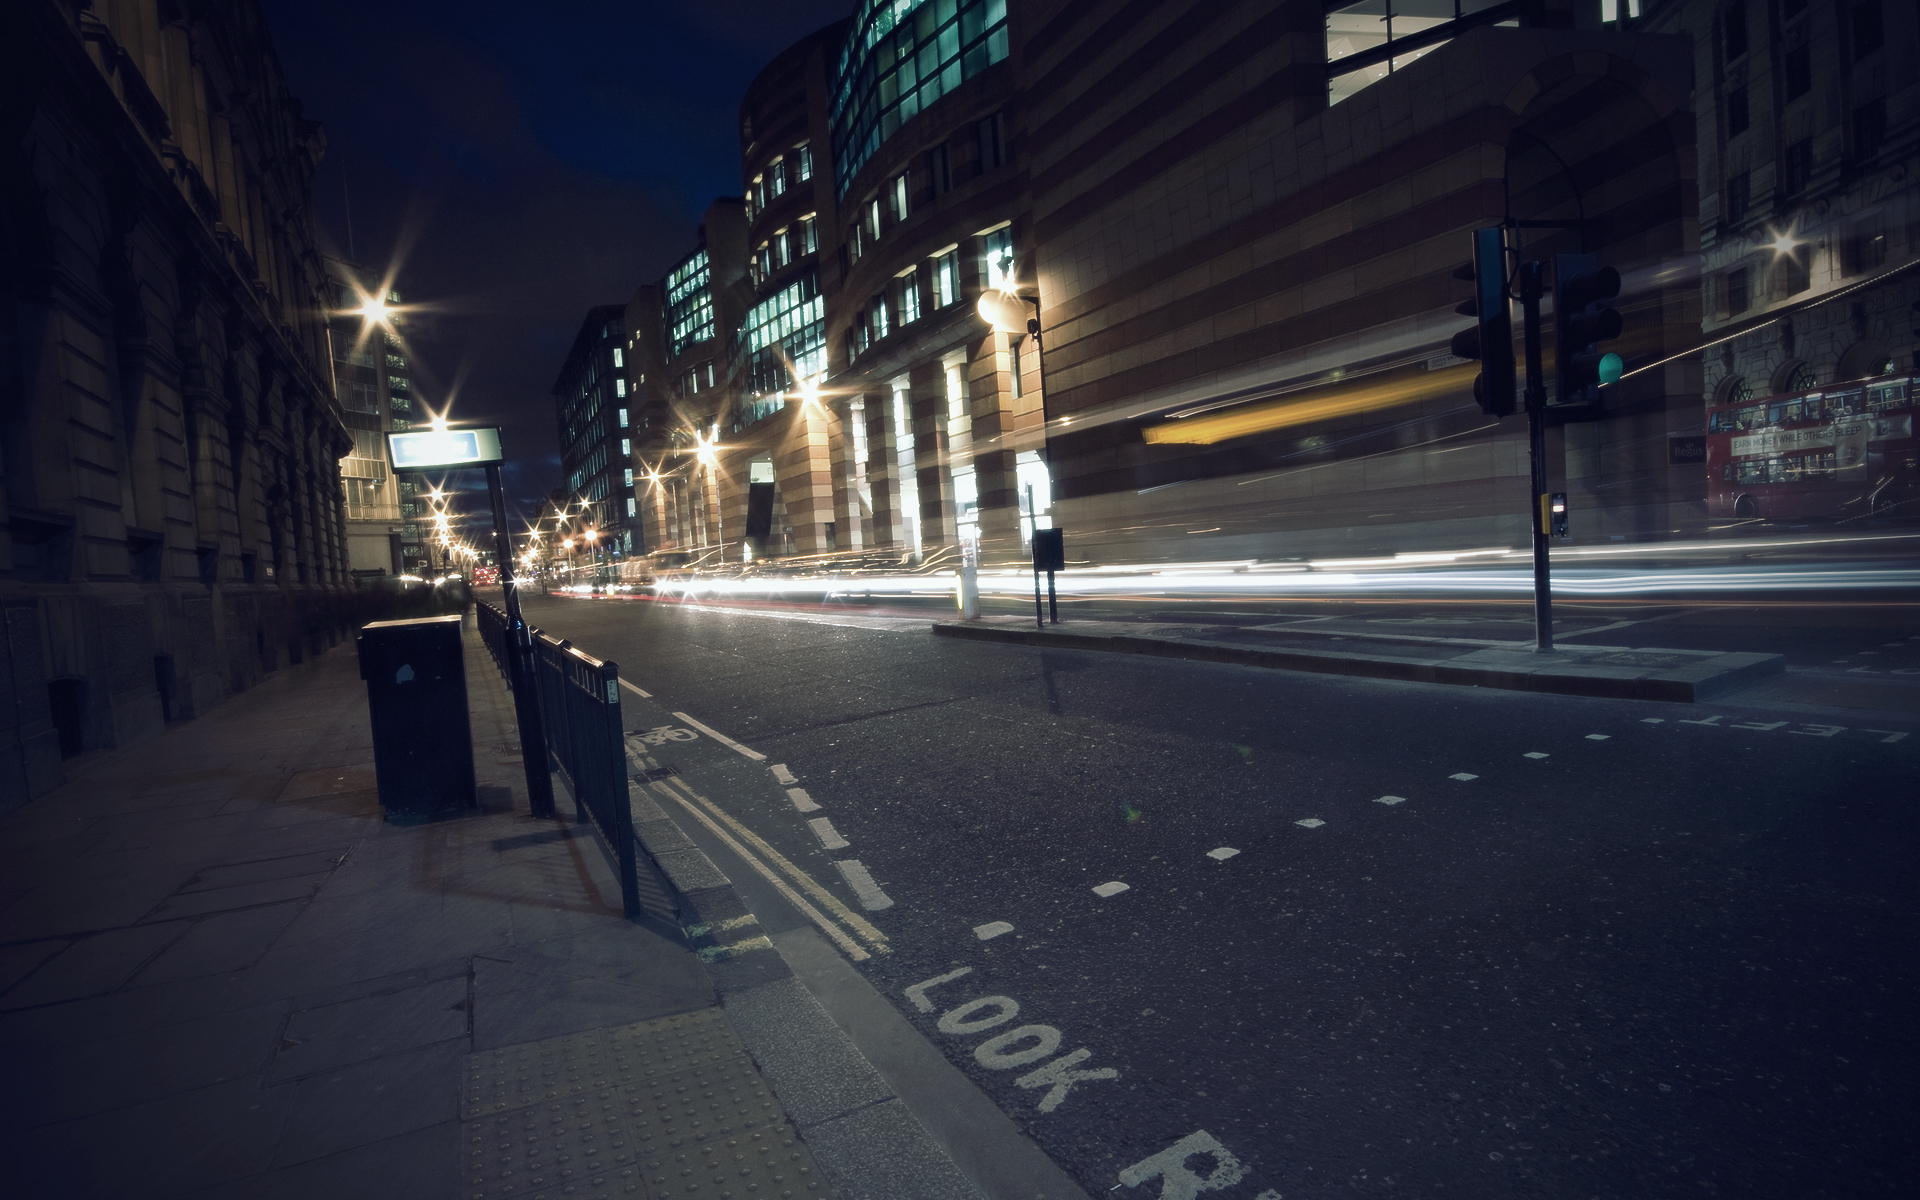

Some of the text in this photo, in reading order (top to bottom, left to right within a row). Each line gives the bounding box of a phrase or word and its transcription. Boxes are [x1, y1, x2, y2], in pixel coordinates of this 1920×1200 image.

[1733, 425, 1862, 449] EARN MONEY WHILE OTHERS SLEEP
[1675, 446, 1703, 458] Regus
[903, 965, 1121, 1114] LOOK
